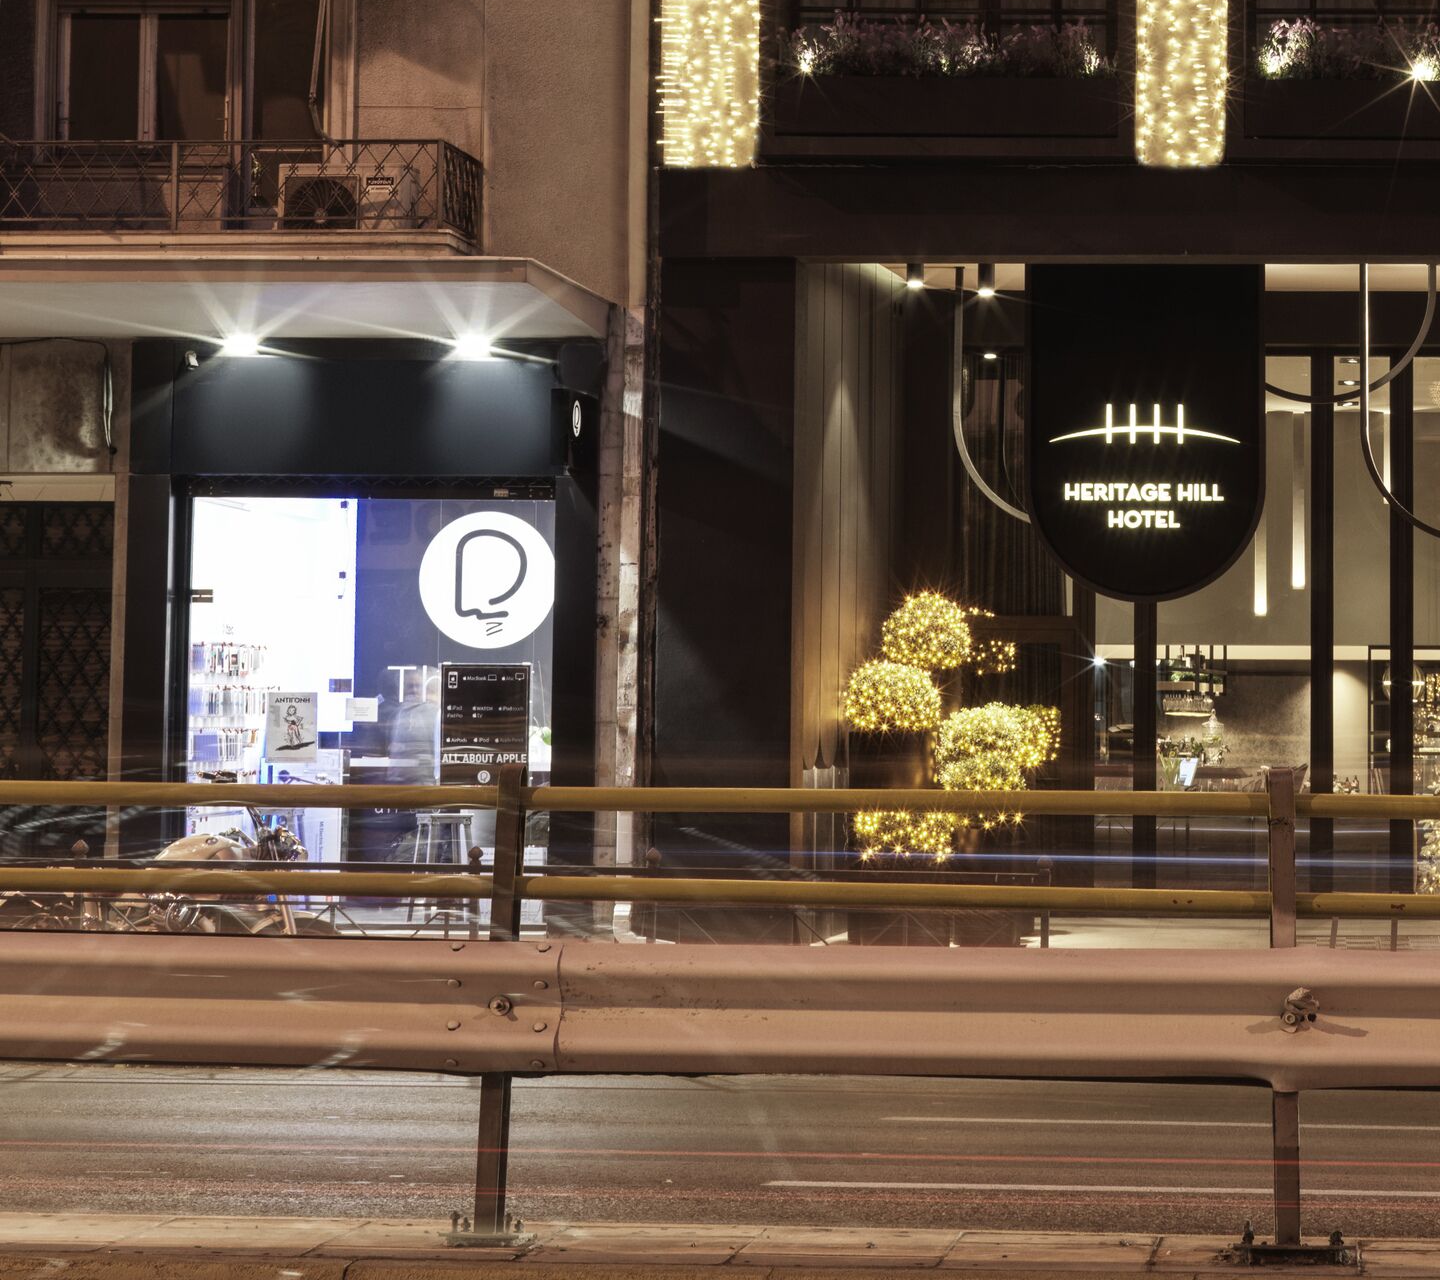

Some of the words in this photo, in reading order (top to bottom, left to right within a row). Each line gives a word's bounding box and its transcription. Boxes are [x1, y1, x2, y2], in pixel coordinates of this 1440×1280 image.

[1064, 483, 1171, 501] HERITAGE
[1177, 483, 1224, 501] HILL
[1107, 510, 1180, 528] HOTEL
[442, 754, 461, 763] ALL
[463, 754, 494, 763] ABOUT
[496, 754, 527, 763] APPLE
